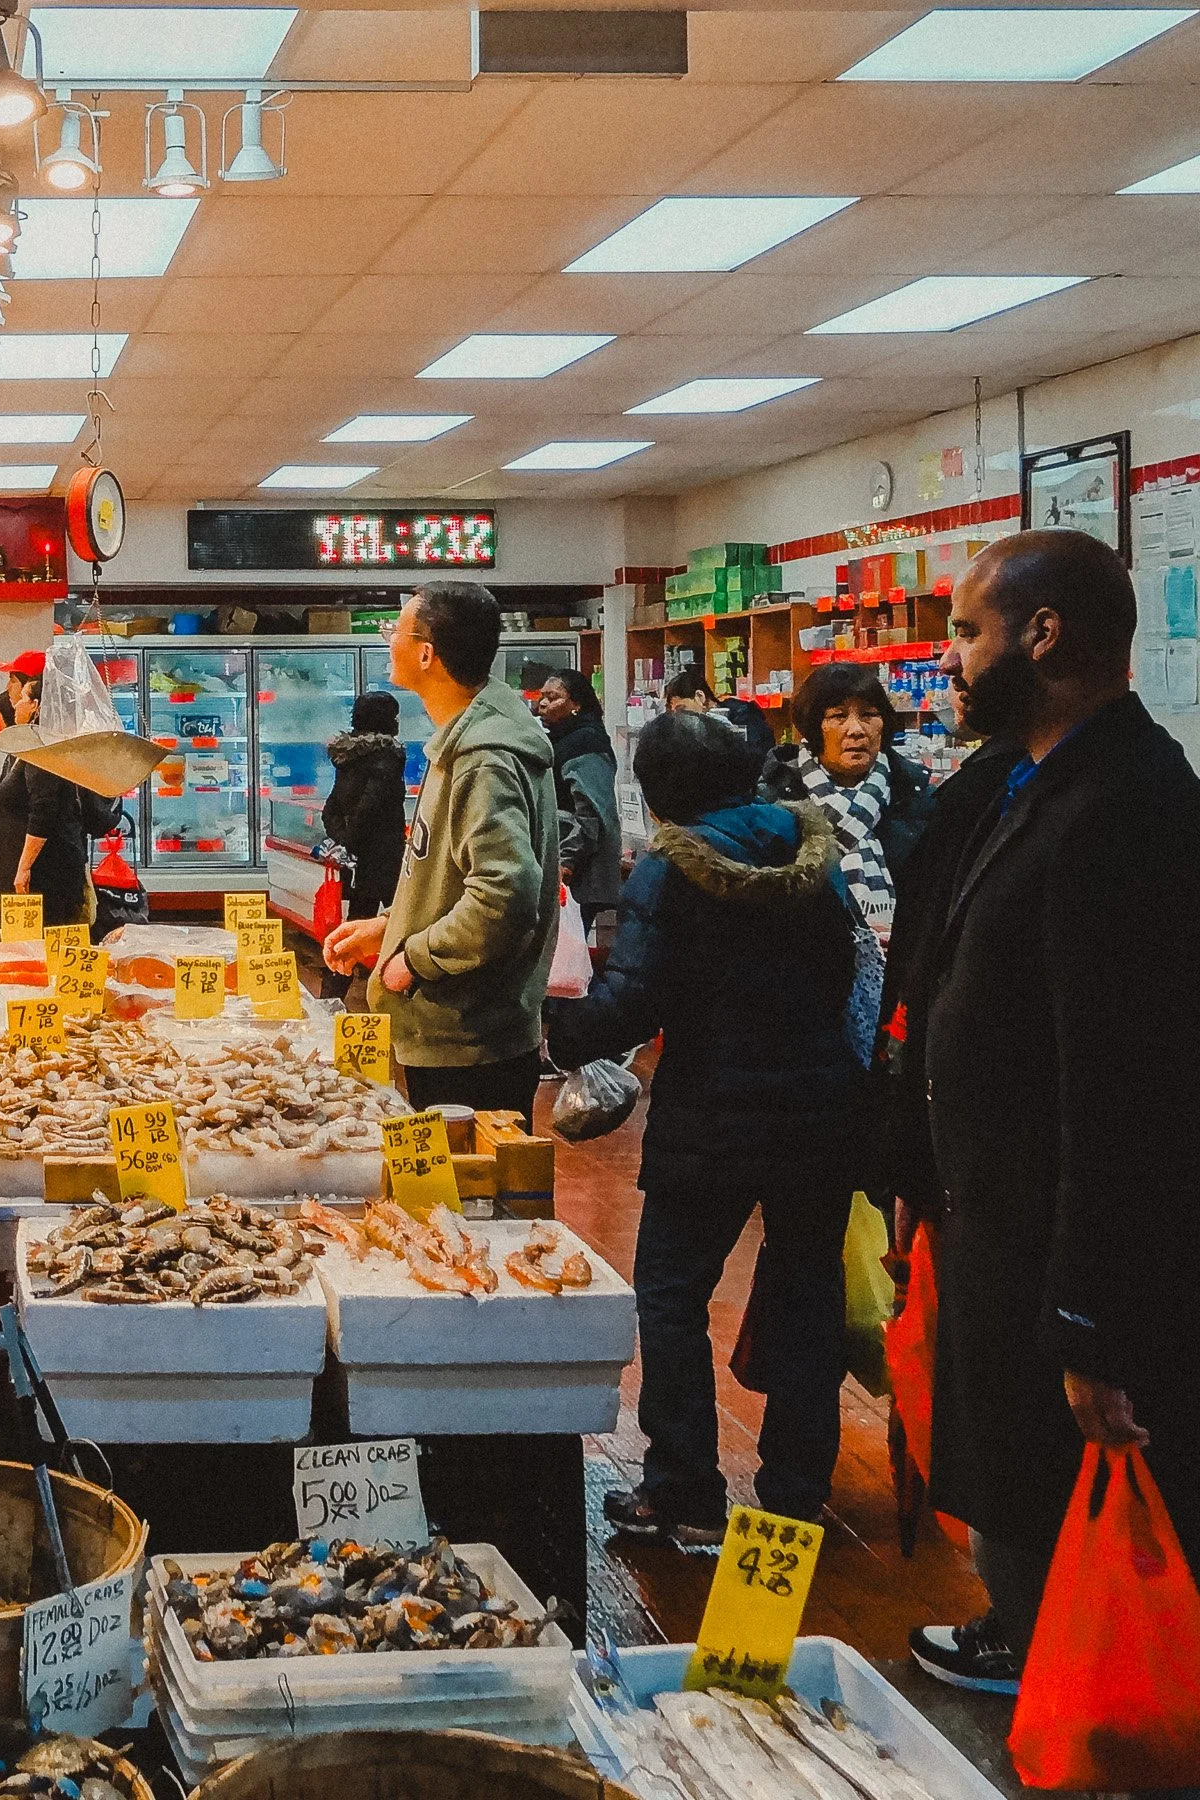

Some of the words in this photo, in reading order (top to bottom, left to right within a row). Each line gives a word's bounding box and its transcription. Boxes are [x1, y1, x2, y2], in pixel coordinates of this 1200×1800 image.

[383, 1121, 405, 1132] WILD
[409, 1112, 442, 1126] CAUGHT
[296, 1446, 360, 1471] CLEAN
[367, 1444, 411, 1463] CRAB
[89, 1614, 122, 1647] DOZ
